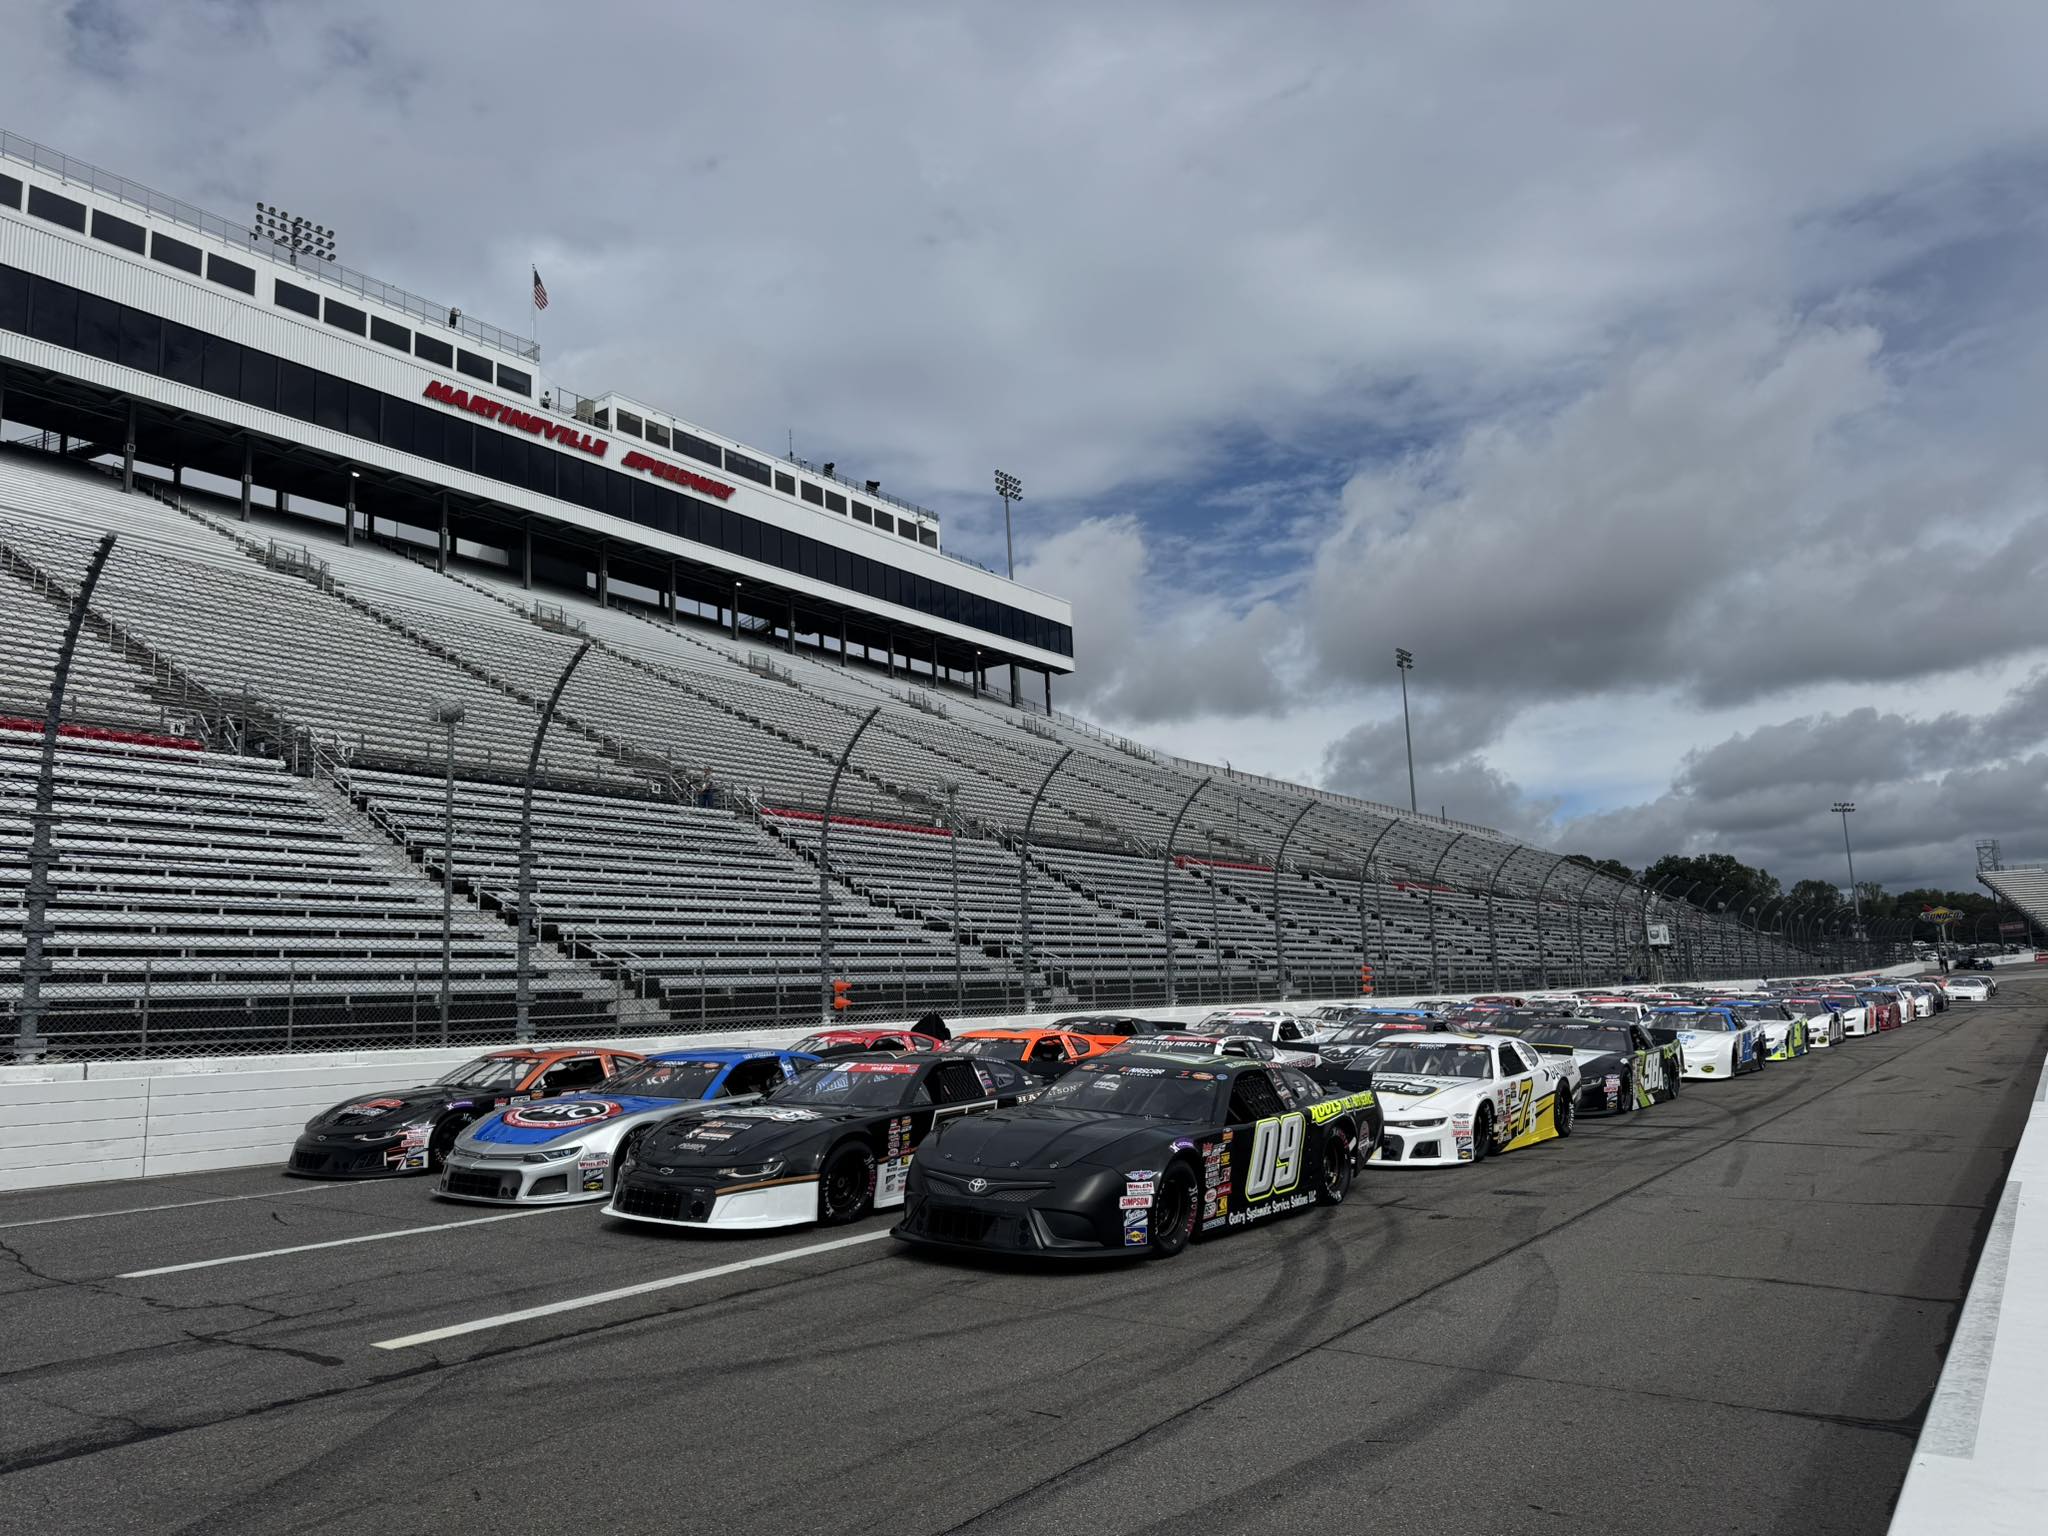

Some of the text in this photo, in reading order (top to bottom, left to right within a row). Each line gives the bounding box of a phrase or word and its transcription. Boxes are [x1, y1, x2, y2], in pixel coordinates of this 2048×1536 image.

[422, 380, 736, 500] MARTINSVILLE SPEEDWAY
[1924, 911, 1964, 920] SUNOCO
[1126, 1039, 1174, 1047] PEMBELTON
[1306, 1100, 1342, 1123] ROOTS
[1246, 1112, 1306, 1202] 09
[579, 1159, 609, 1169] WHELEN
[1127, 1182, 1153, 1190] WHELEN
[1121, 1197, 1150, 1207] SIMPSON
[1228, 1190, 1317, 1226] Gentry Systematic Service Solutions LLC
